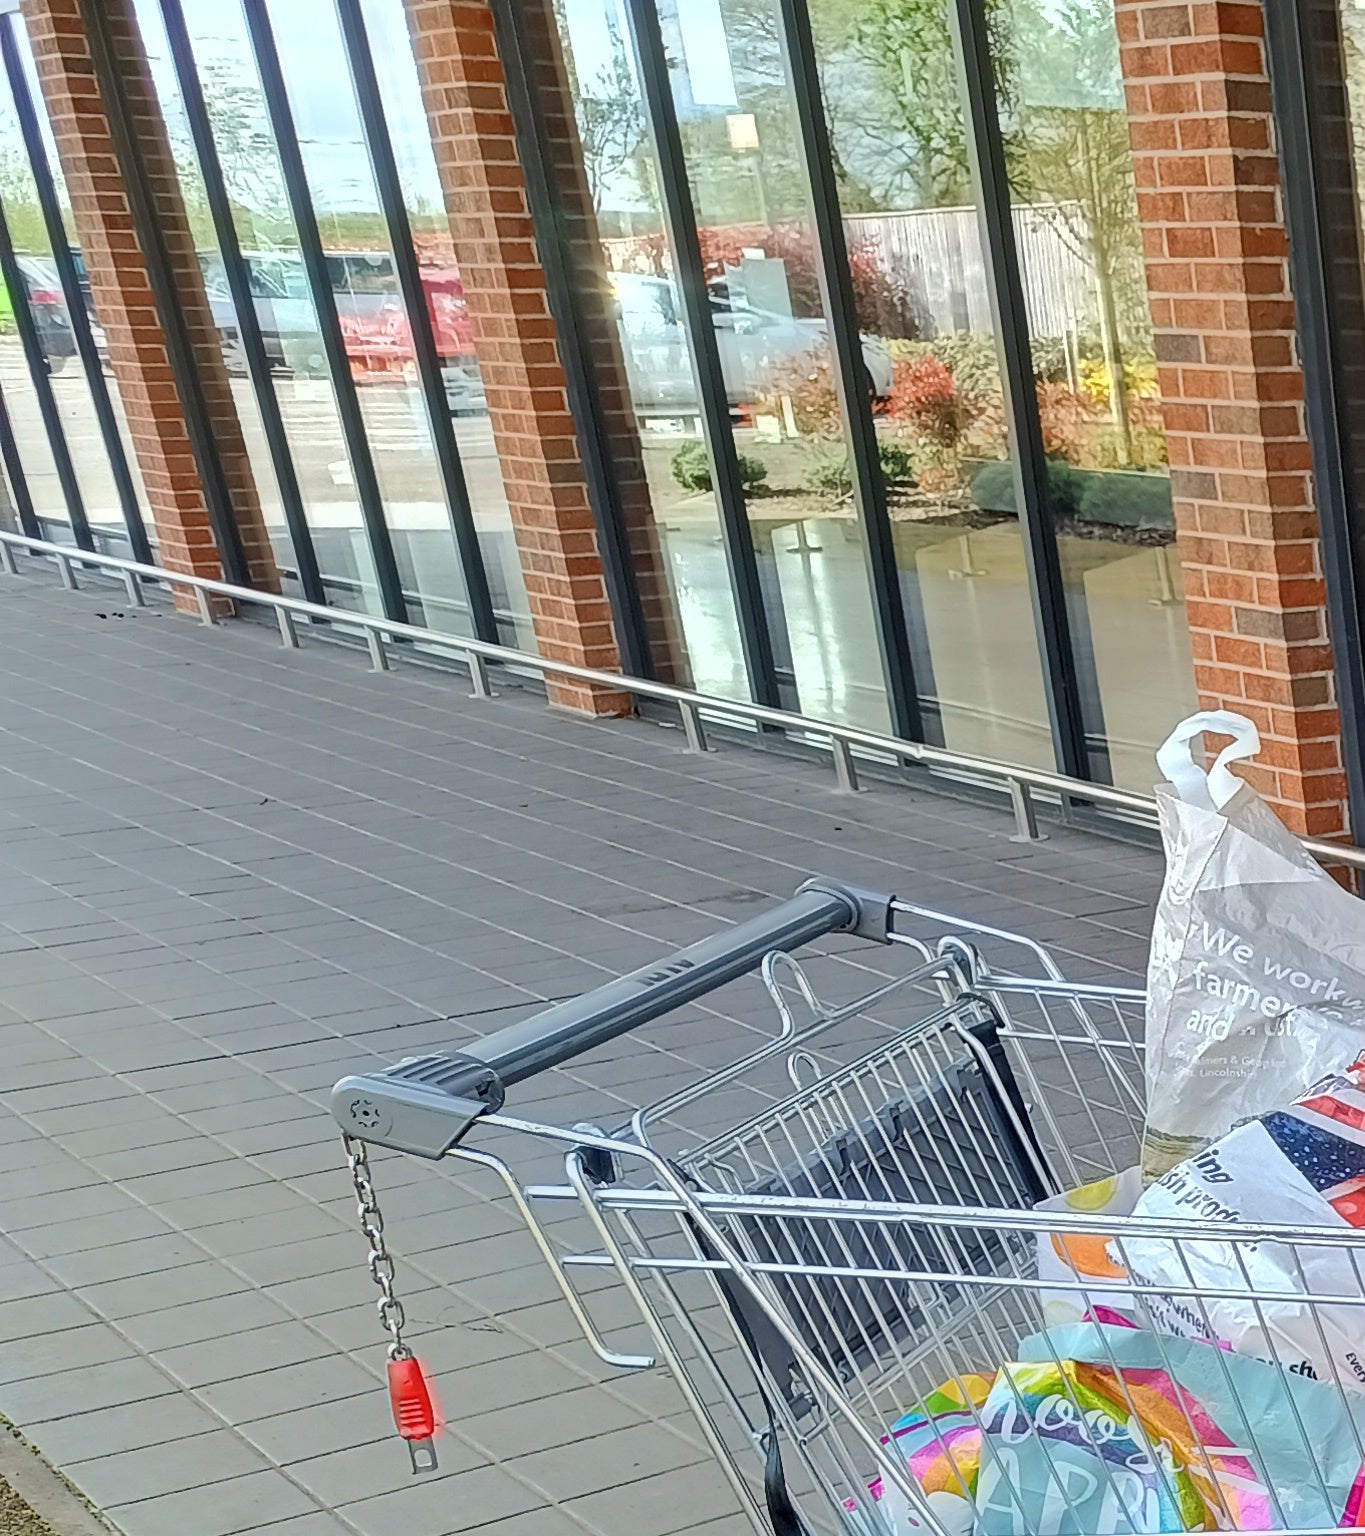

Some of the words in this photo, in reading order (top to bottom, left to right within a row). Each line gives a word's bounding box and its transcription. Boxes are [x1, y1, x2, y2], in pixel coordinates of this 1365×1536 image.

[1192, 960, 1312, 1019] farmer
[1202, 920, 1254, 965] We
[1263, 956, 1346, 1001] work
[1186, 1007, 1236, 1041] and
